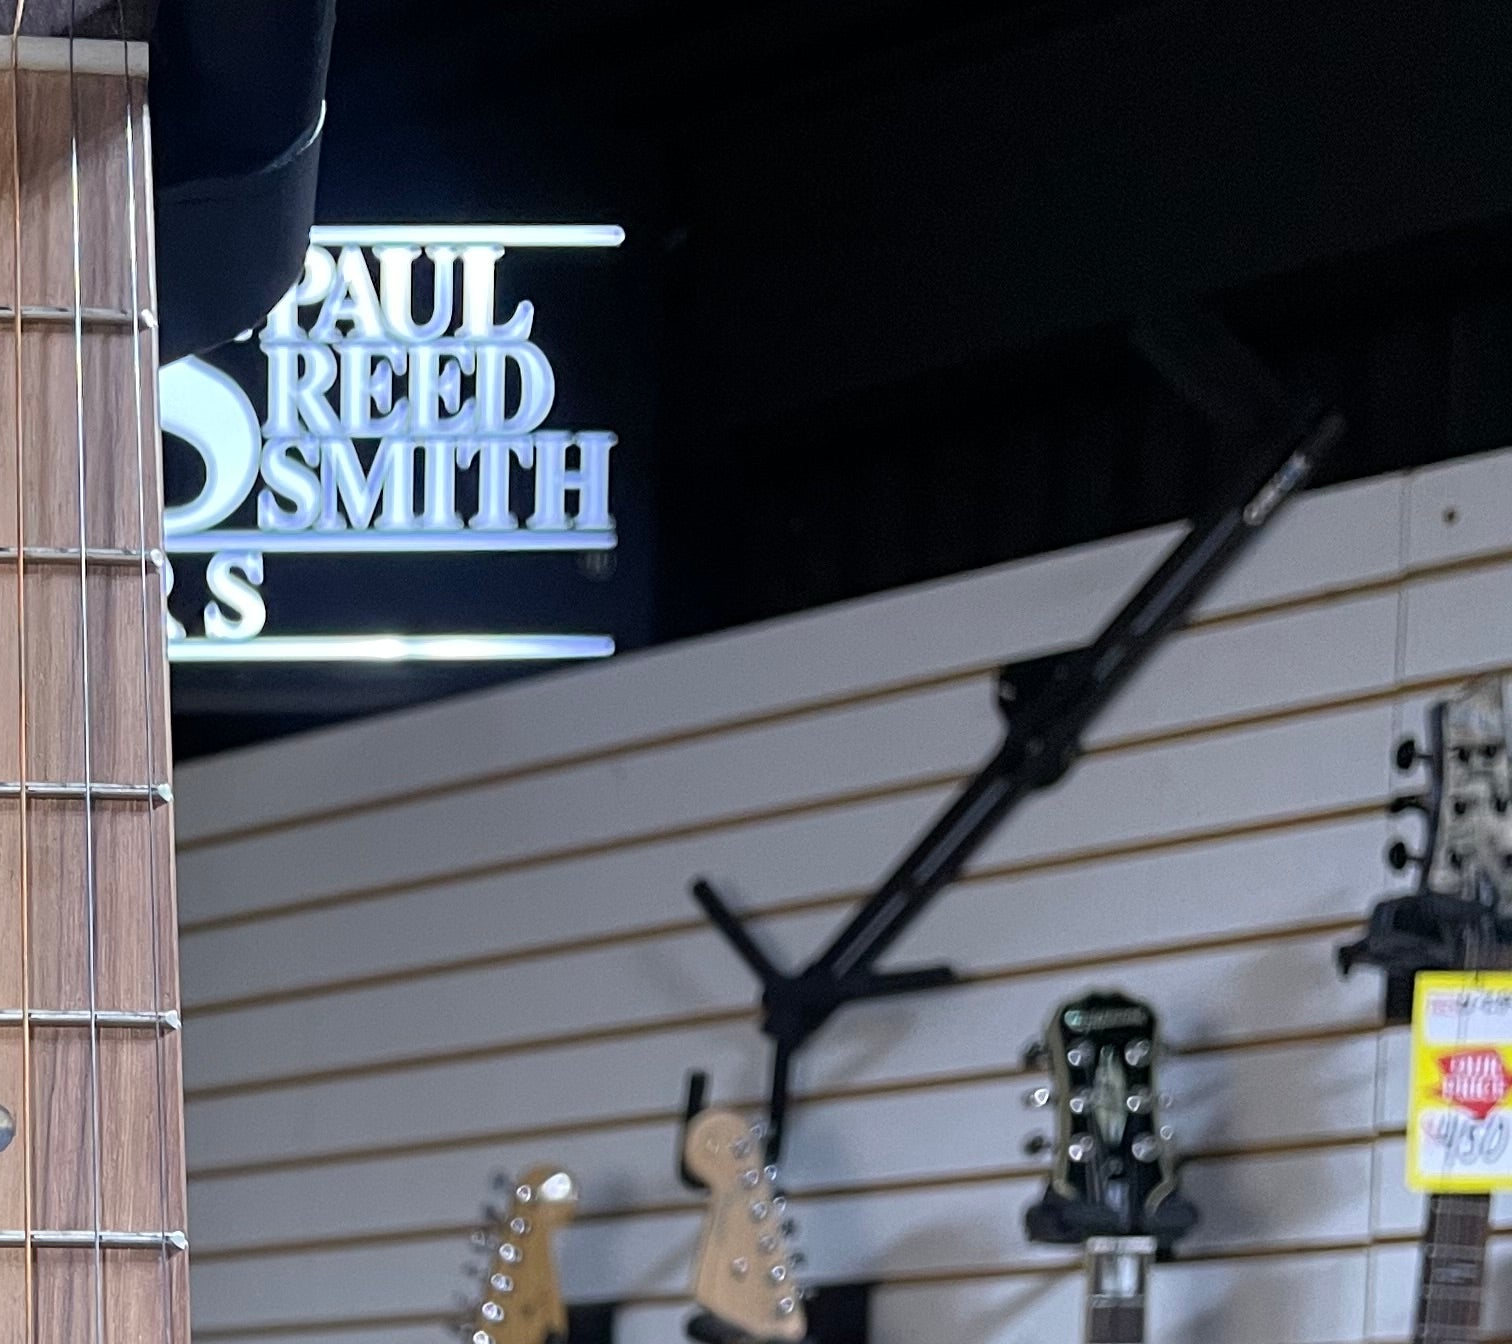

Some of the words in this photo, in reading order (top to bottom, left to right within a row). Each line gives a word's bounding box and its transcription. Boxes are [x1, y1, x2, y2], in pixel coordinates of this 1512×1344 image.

[259, 244, 534, 341] PAUL
[260, 341, 555, 438] REED
[257, 430, 619, 531] SMITH
